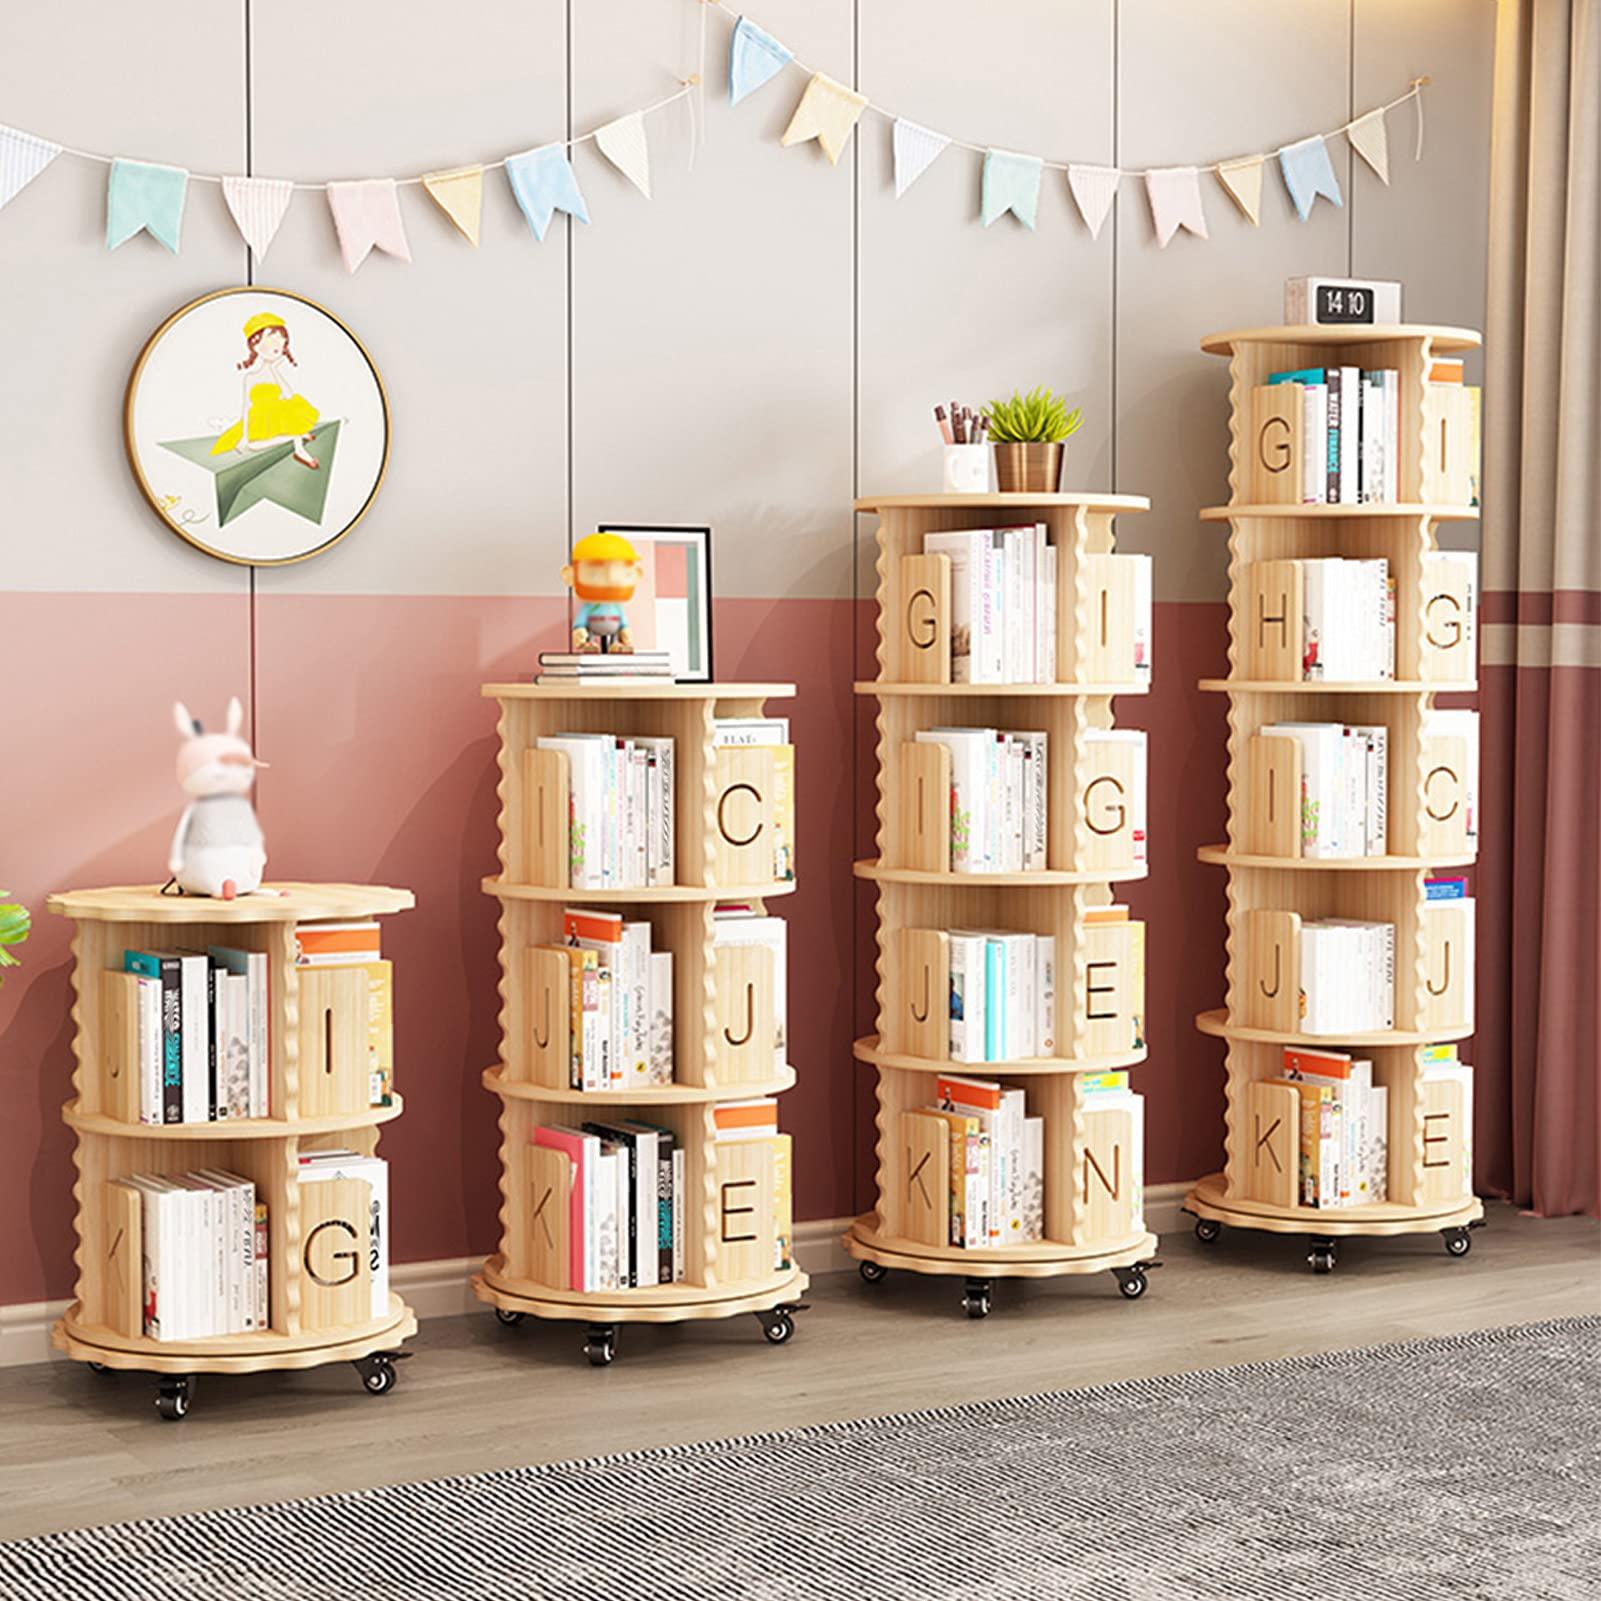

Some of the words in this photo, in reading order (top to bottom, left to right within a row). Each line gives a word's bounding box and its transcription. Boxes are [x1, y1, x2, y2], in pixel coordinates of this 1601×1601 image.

[1327, 291, 1343, 314] 14
[1348, 292, 1365, 315] 10
[1260, 416, 1291, 474] G
[907, 588, 937, 649] G
[1100, 589, 1107, 647] I
[1259, 593, 1287, 649] H
[1426, 593, 1461, 650] G
[718, 783, 764, 847] C
[1083, 775, 1126, 836] G
[1424, 766, 1458, 822] C
[911, 965, 930, 1023] J
[1086, 961, 1117, 1020] E
[1260, 943, 1281, 999] J
[1427, 940, 1450, 996] J
[325, 1007, 332, 1075] I
[533, 987, 551, 1049] J
[723, 982, 754, 1047] J
[1255, 1113, 1282, 1173] K
[1422, 1112, 1451, 1168] E
[907, 1145, 932, 1210] K
[1083, 1144, 1119, 1205] N
[531, 1181, 554, 1249] K
[721, 1179, 757, 1243] E
[303, 1218, 360, 1288] G
